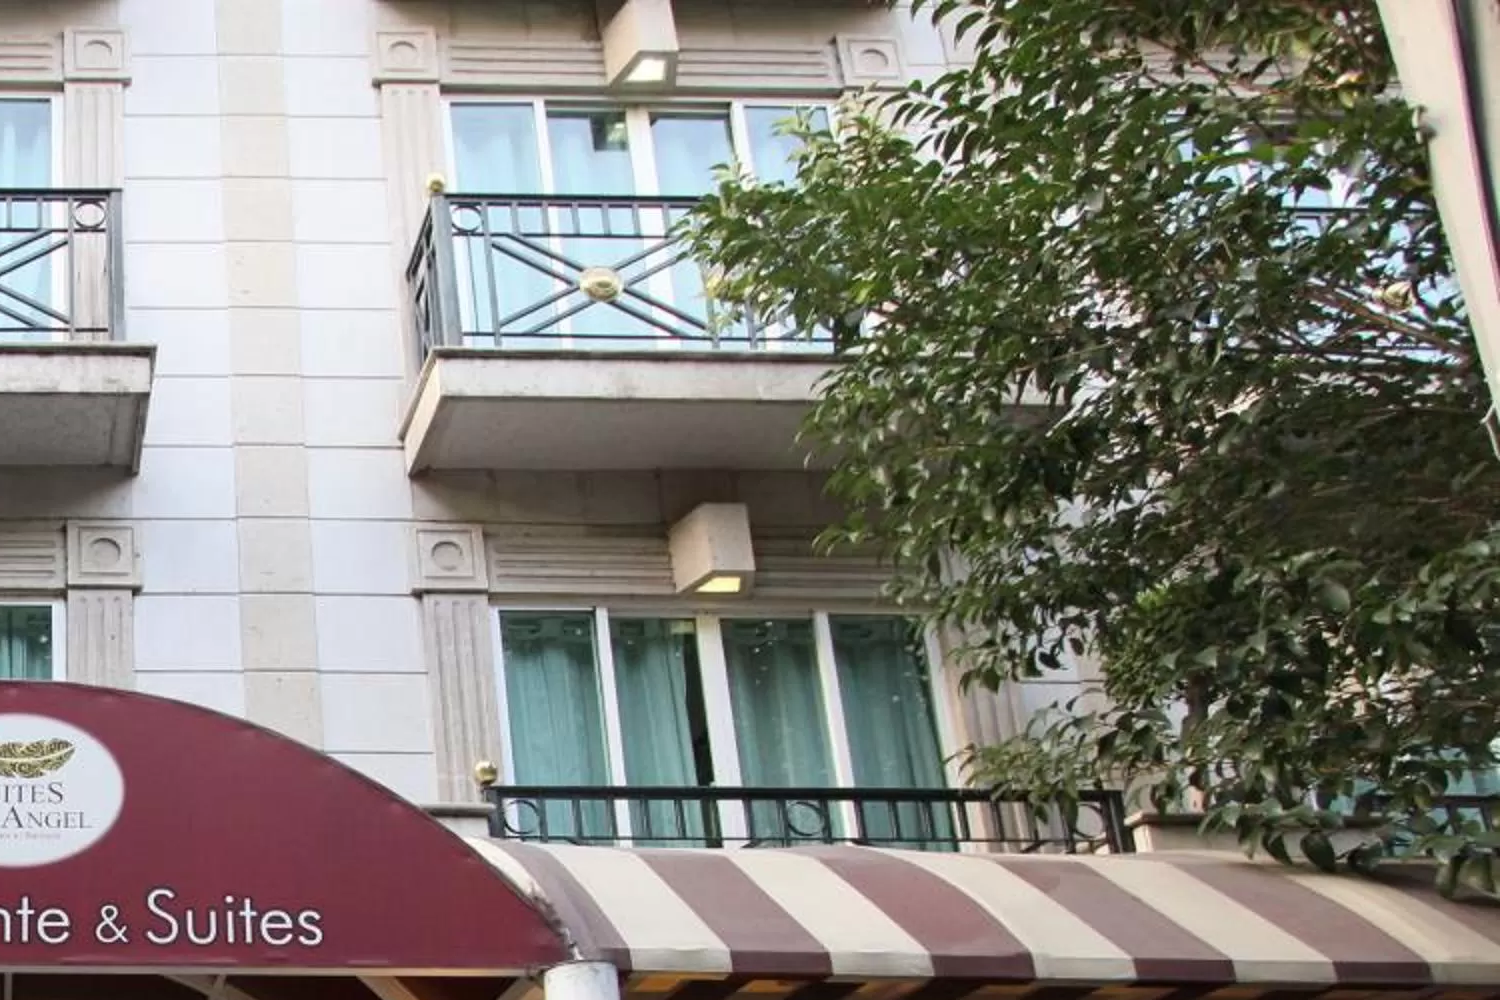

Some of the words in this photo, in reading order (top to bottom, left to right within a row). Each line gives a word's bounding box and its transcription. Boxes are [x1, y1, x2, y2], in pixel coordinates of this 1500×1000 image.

[1, 805, 92, 829] ANGEL
[95, 904, 129, 943] &
[146, 888, 323, 945] Suites
